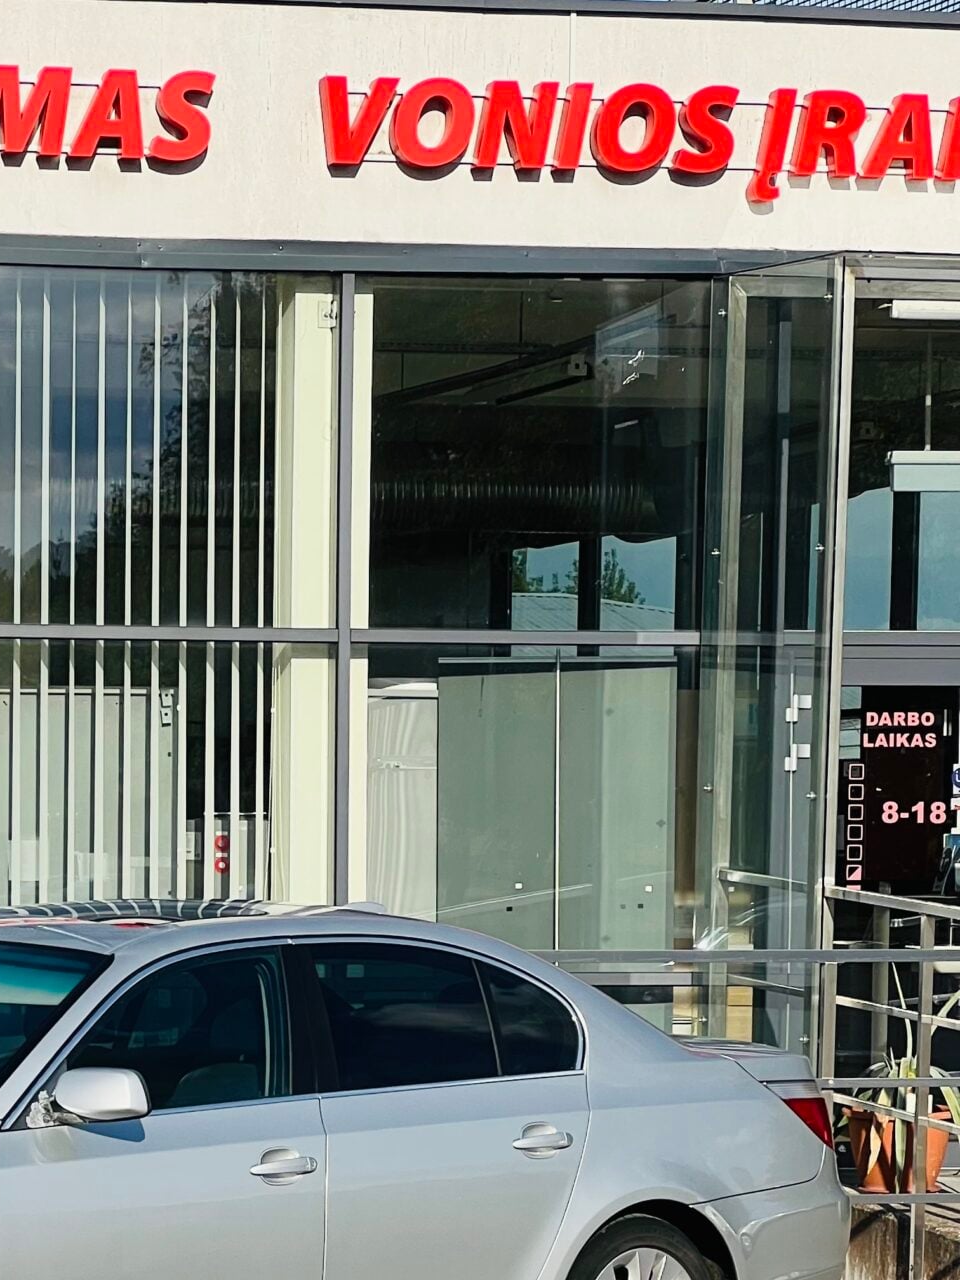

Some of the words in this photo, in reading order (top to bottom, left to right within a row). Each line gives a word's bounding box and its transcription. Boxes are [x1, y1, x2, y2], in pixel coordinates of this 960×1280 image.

[319, 75, 740, 174] VONIOS
[866, 711, 935, 727] DARBO
[863, 733, 937, 748] LAIKAS
[881, 801, 947, 824] 8-18
